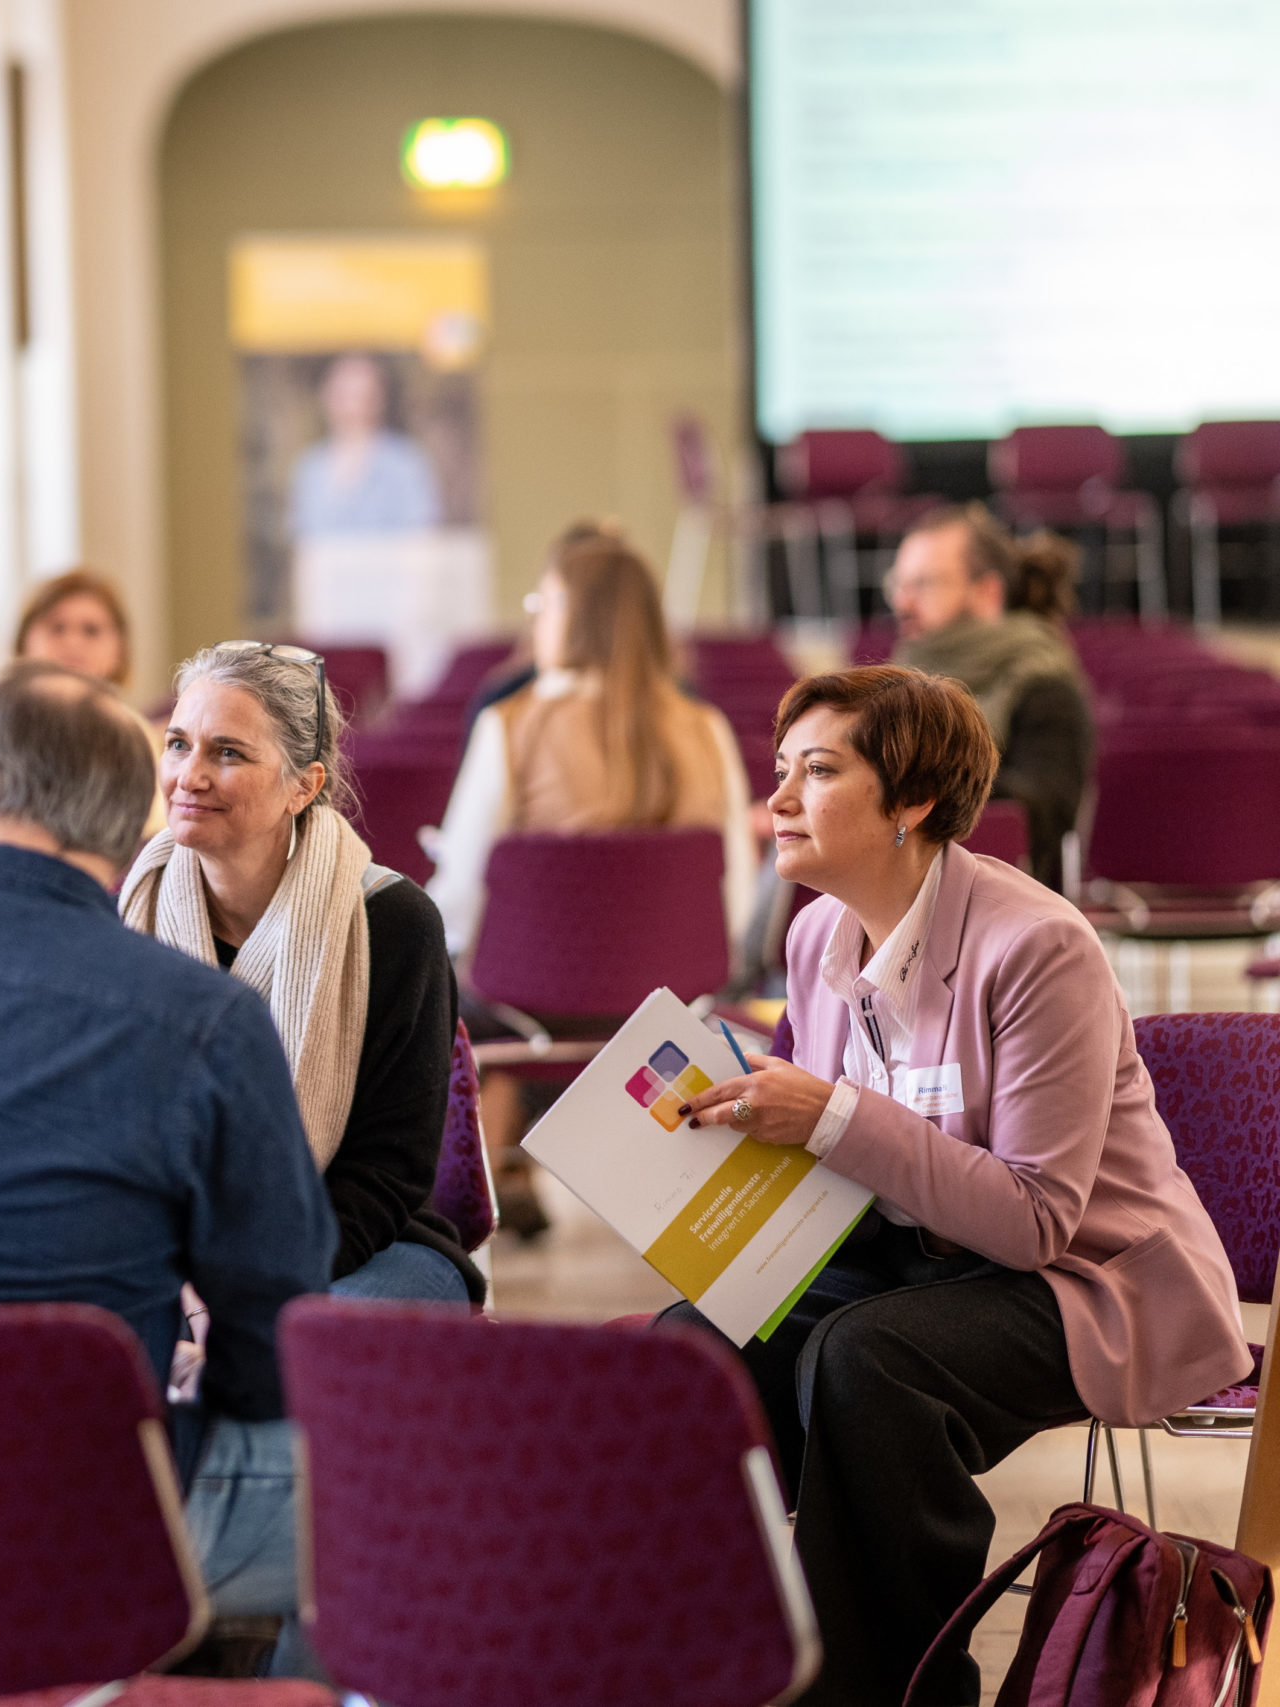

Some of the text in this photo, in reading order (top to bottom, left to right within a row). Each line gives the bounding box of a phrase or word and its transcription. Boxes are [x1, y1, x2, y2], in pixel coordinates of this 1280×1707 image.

[918, 1086, 942, 1094] Rimma
[689, 1186, 733, 1234] Servicestelle
[699, 1172, 761, 1243] Freiwilligendienste
[708, 1156, 792, 1252] Integriert in Sachsen-Anhalt
